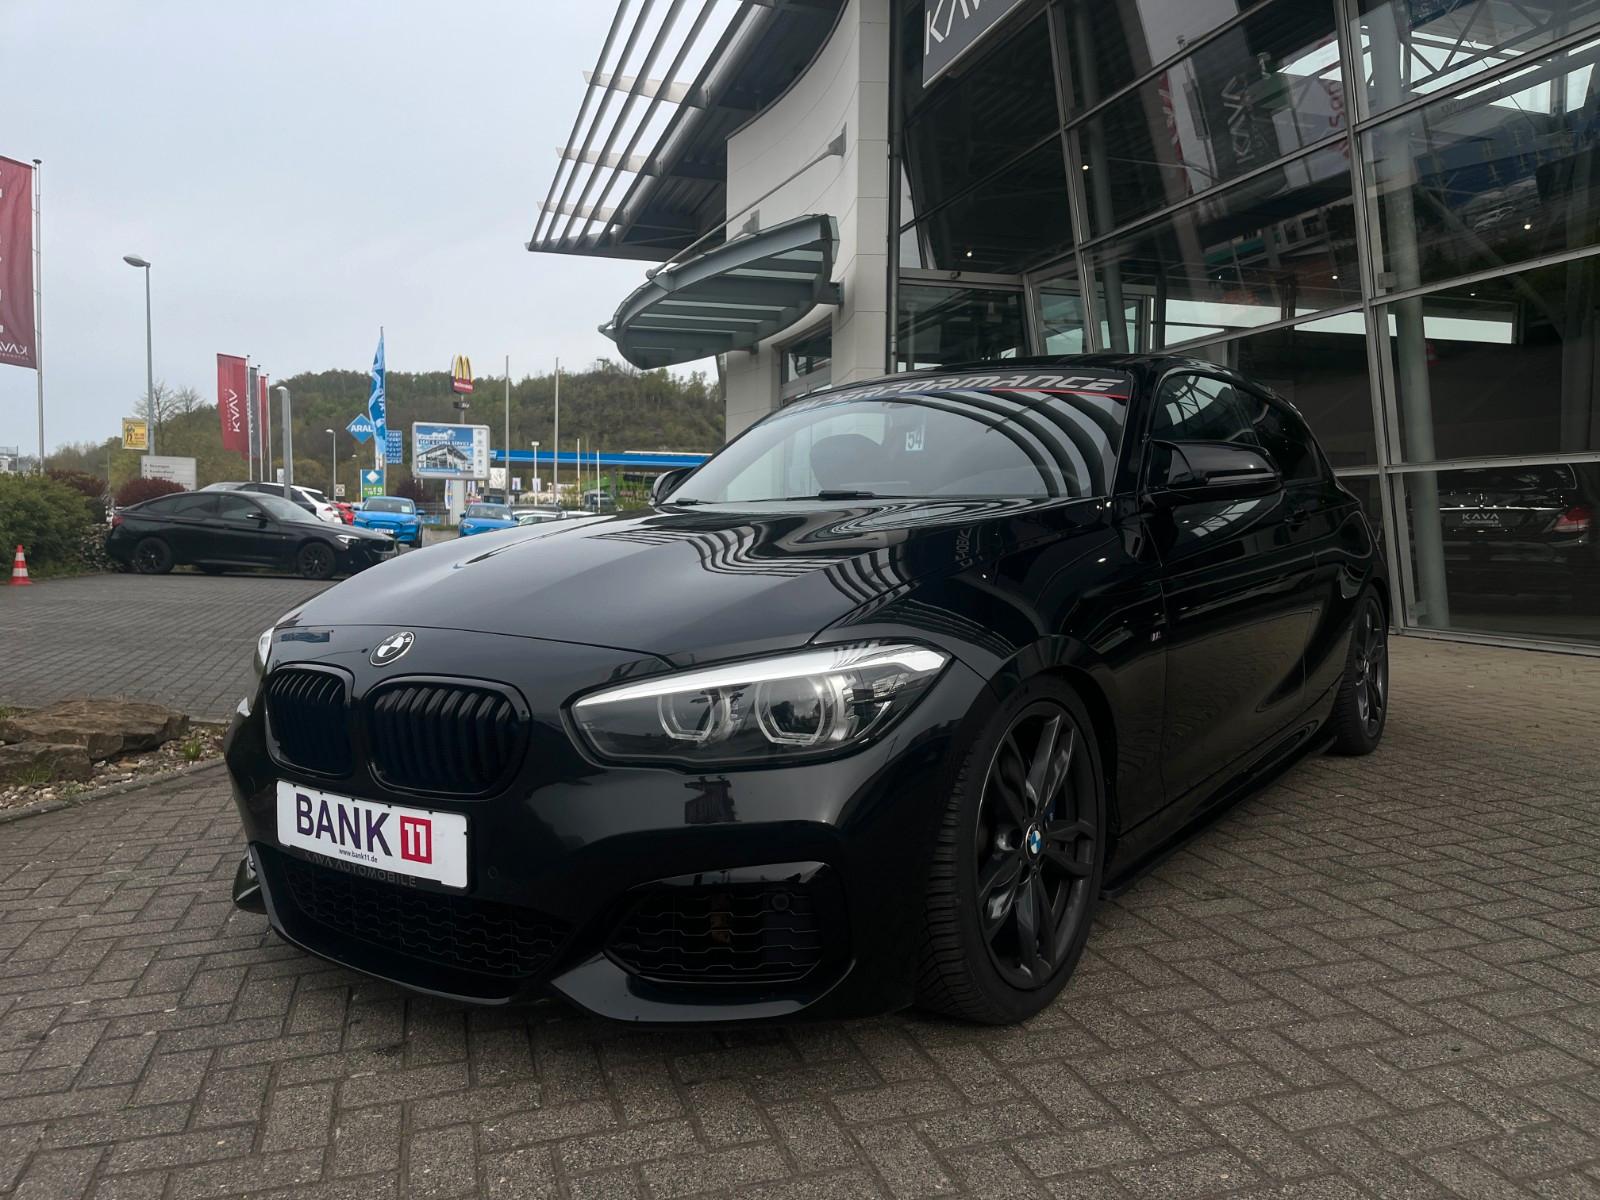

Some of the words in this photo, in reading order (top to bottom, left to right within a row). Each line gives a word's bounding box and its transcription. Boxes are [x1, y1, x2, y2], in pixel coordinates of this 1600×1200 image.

[350, 424, 374, 433] ARAL
[295, 792, 393, 857] BANK
[403, 821, 428, 859] 11
[338, 848, 378, 863] www.bank11.de
[335, 860, 417, 888] AUTOMOBILE
